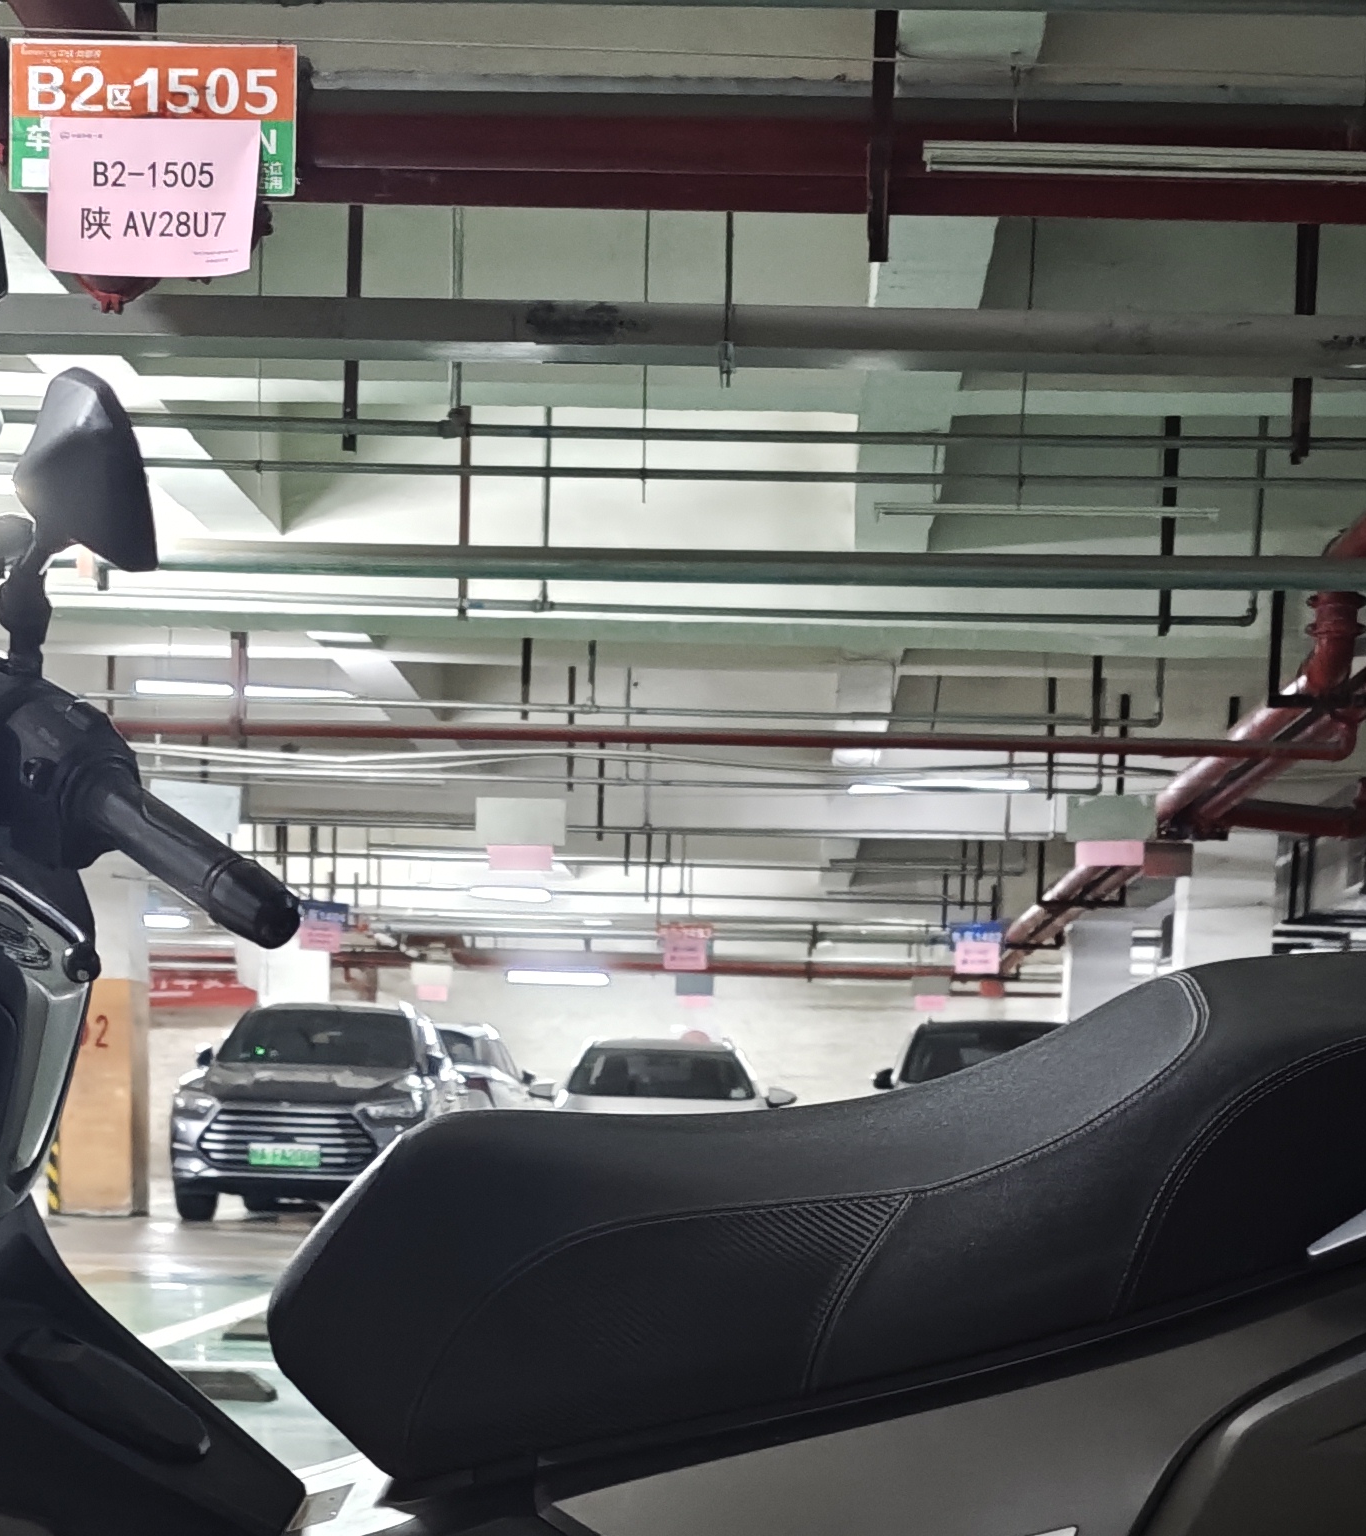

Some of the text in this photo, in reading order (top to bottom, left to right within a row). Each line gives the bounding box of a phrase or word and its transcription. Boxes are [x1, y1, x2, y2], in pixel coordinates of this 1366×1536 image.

[27, 65, 279, 115] B2区1505
[92, 160, 215, 188] B2-1505
[80, 206, 227, 239] 陕 AV28U7
